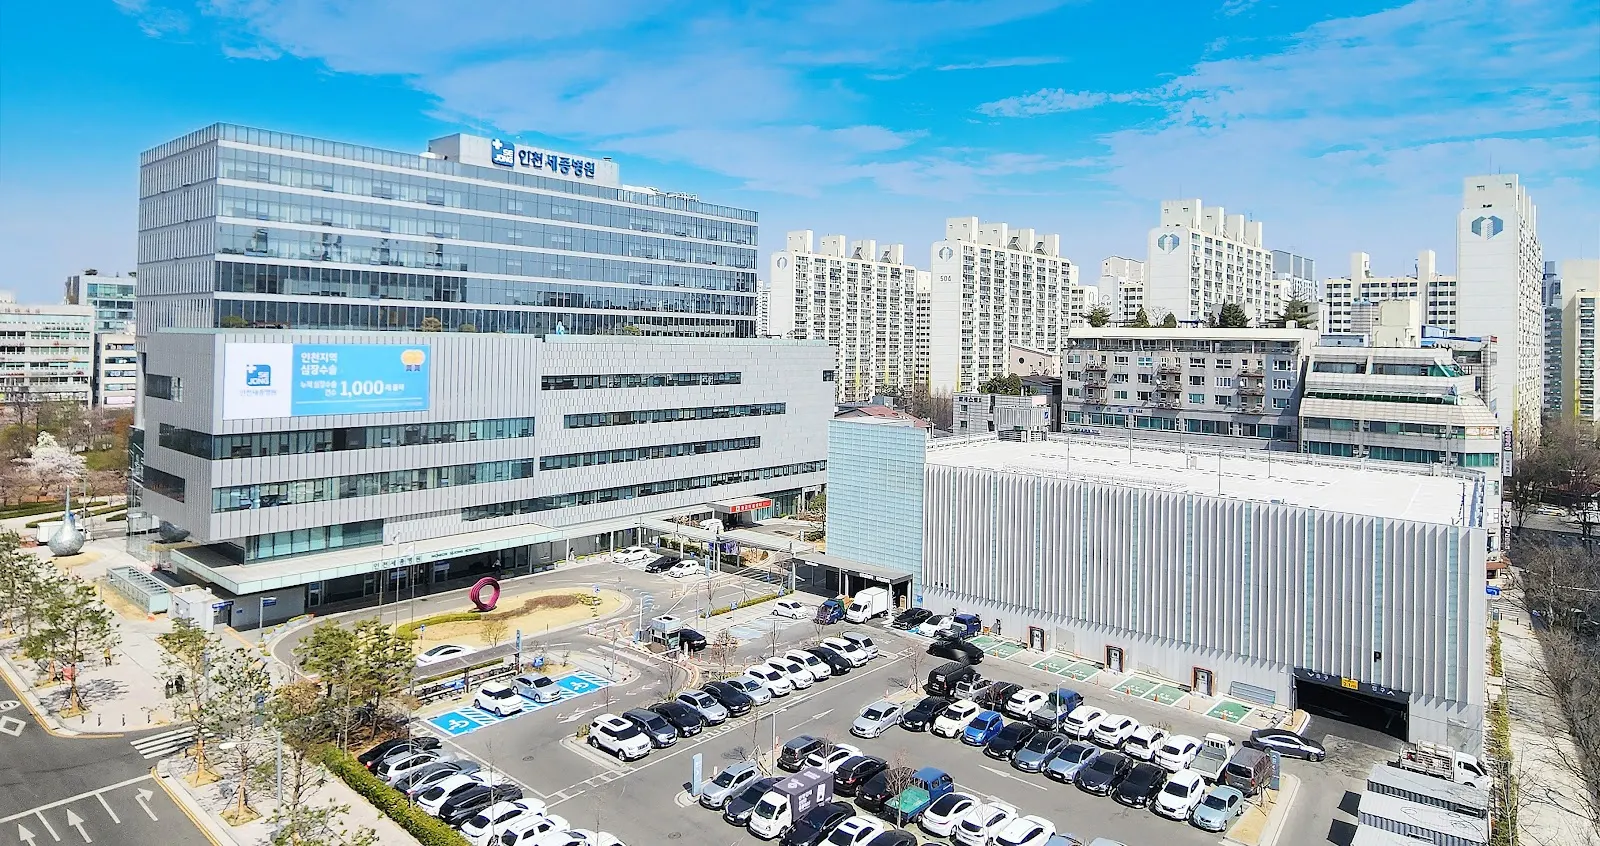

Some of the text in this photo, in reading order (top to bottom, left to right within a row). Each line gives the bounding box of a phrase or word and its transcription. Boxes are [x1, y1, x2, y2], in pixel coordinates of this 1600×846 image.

[503, 149, 513, 157] SE
[494, 154, 513, 163] JONG
[301, 353, 338, 364] 인천지역
[301, 365, 338, 376] 심장수술
[247, 377, 270, 385] JONG
[1374, 651, 1381, 662] P
